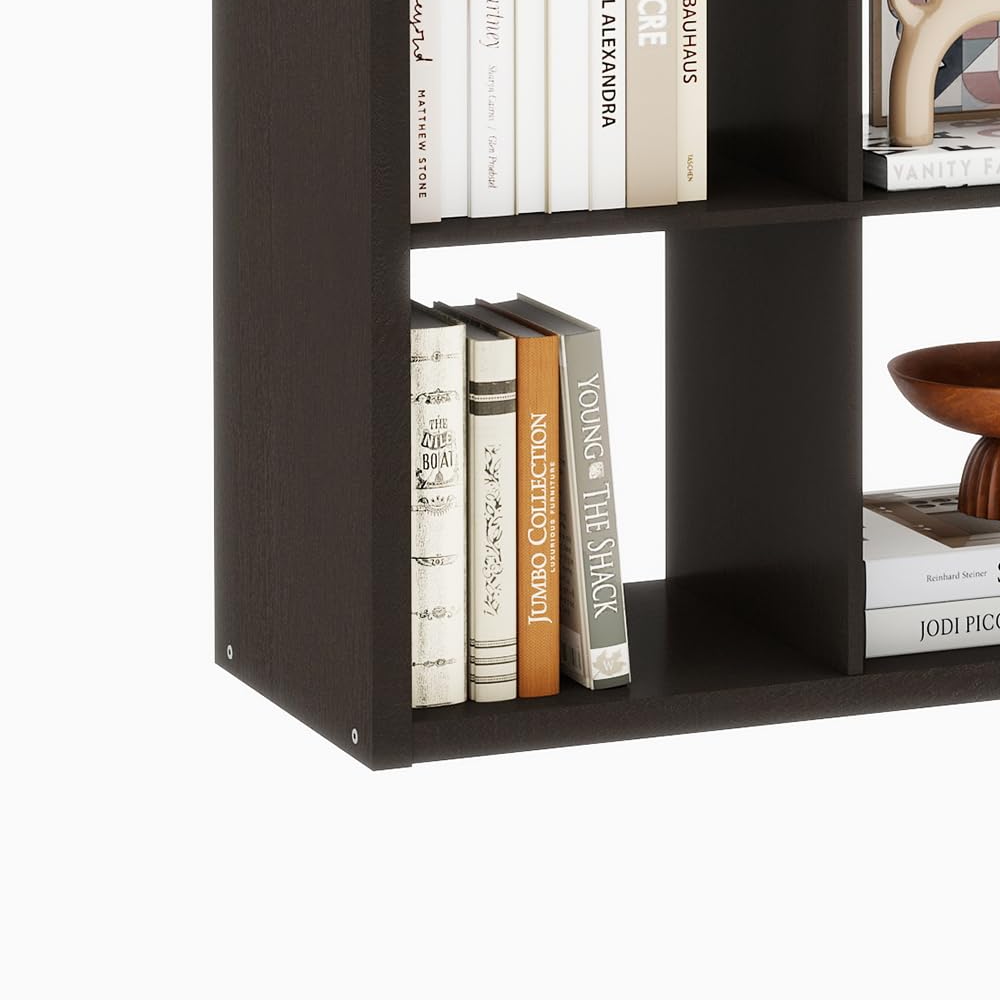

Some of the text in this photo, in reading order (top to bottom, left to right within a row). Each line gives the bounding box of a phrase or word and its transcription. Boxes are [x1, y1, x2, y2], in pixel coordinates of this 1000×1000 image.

[601, 14, 617, 129] ALEXANDRA
[417, 88, 427, 200] MATTHEW STONE
[893, 159, 972, 181] VANITY
[428, 418, 448, 430] THE
[422, 450, 453, 470] BOAT
[527, 412, 554, 626] JUMBO COLLECTION
[549, 460, 557, 574] LUXURIOUS FURNITURE
[577, 372, 619, 620] YOUNG THE SHACK
[926, 569, 988, 583] Reinhard Steiner
[919, 617, 960, 643] JODI
